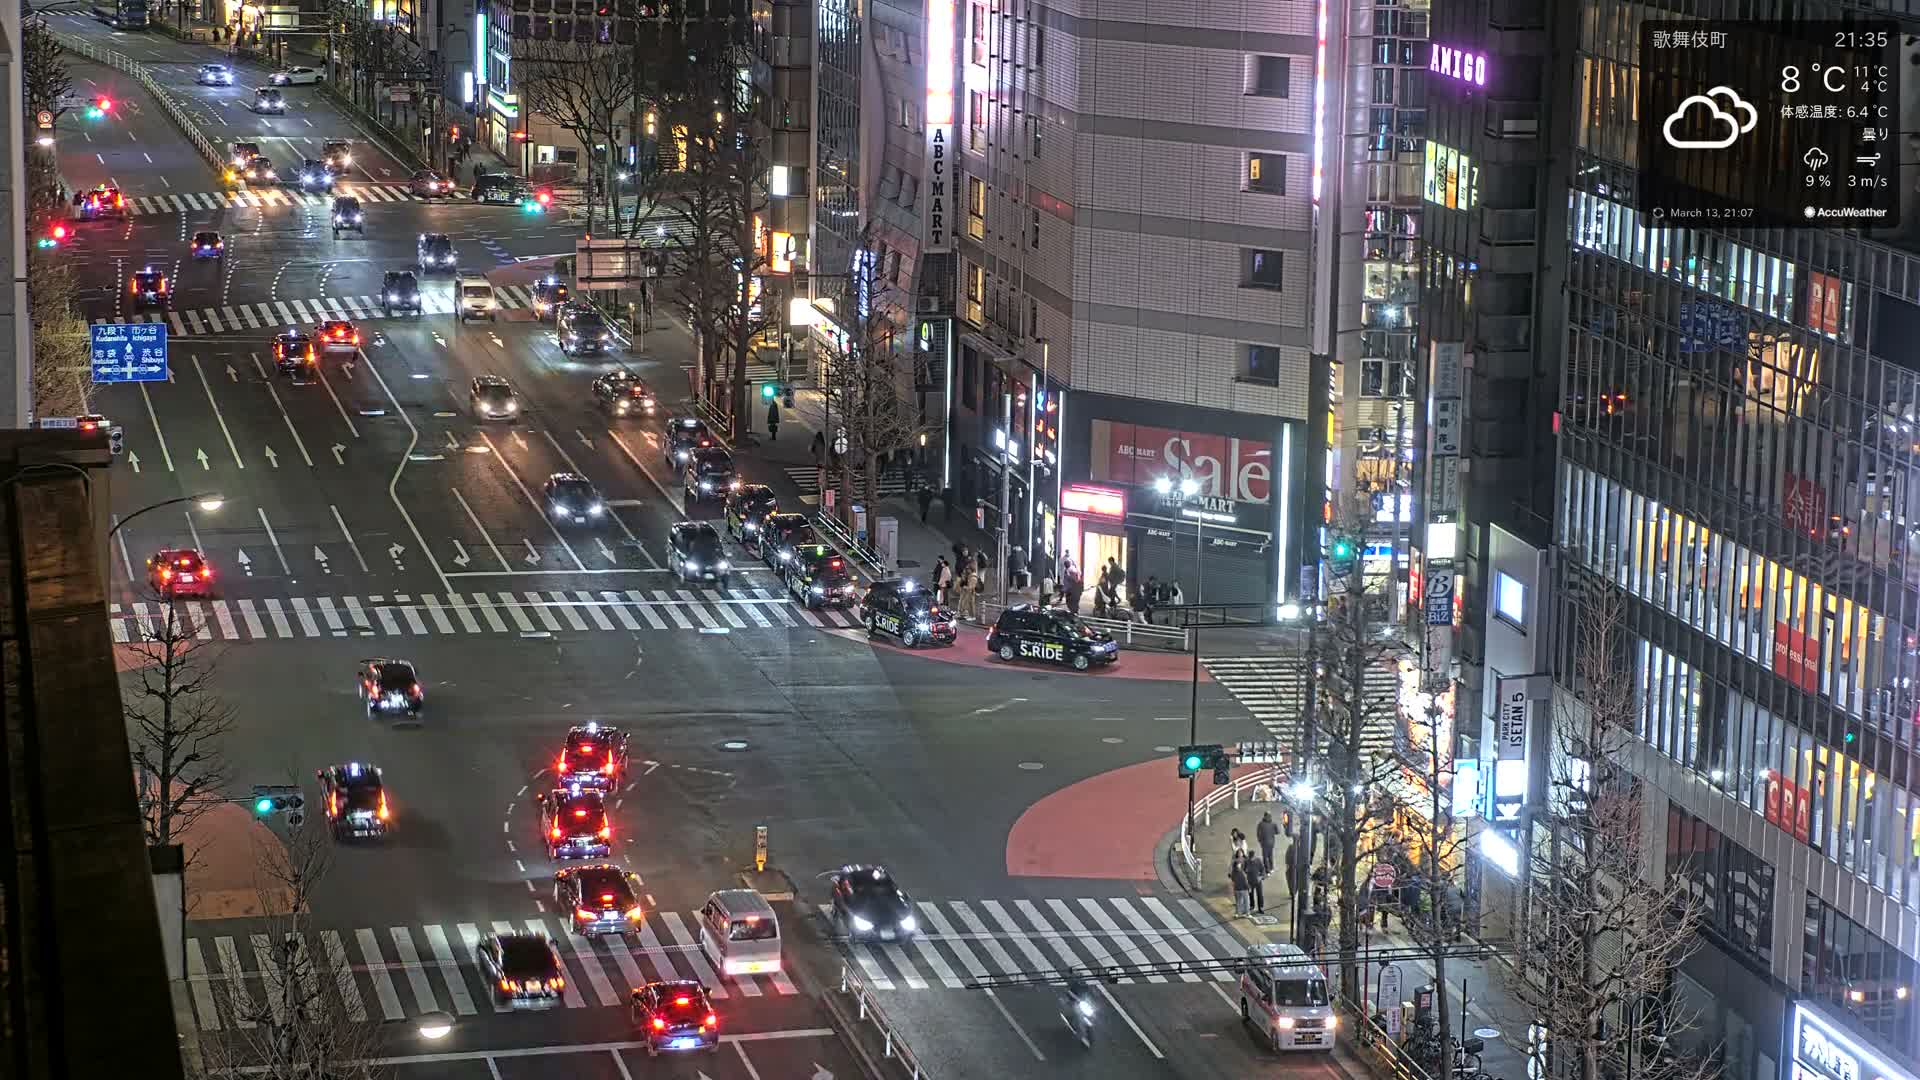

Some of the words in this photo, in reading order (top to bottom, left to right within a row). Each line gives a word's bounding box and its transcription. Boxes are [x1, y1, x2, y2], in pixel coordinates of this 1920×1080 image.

[1430, 43, 1485, 86] AMIGO
[97, 326, 126, 335] 九段下
[1164, 436, 1272, 506] Sale
[875, 614, 899, 634] S.RIDE
[1020, 645, 1063, 661] S.RIDE
[1512, 692, 1524, 702] 5
[1502, 704, 1511, 719] CITY
[1501, 722, 1510, 740] PARK
[1510, 706, 1524, 747] ISETAN
[1769, 781, 1807, 830] CPA
